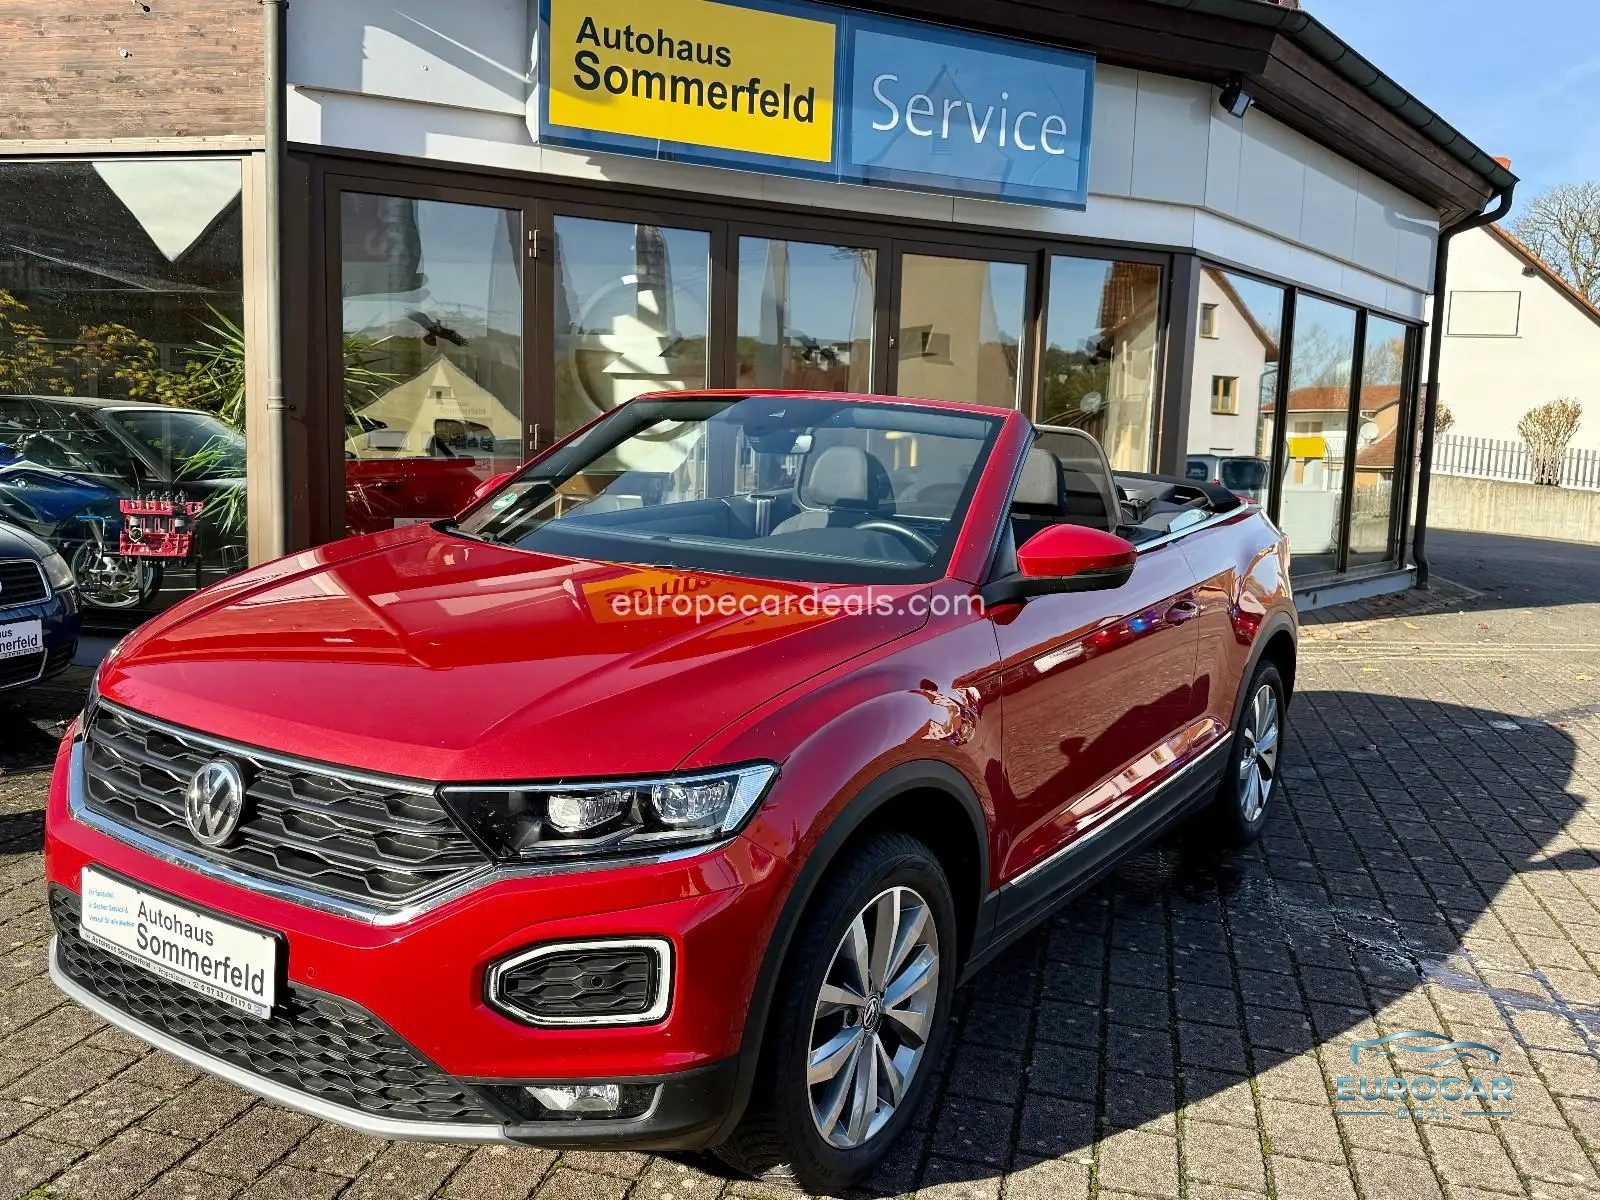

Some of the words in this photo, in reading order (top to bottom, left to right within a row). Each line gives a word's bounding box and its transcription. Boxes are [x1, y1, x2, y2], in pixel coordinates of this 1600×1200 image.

[575, 16, 732, 68] Autohaus
[573, 49, 815, 124] Sommerfeld
[871, 72, 1068, 155] Service
[136, 922, 265, 997] Sommerfeld
[138, 900, 214, 946] Autohaus
